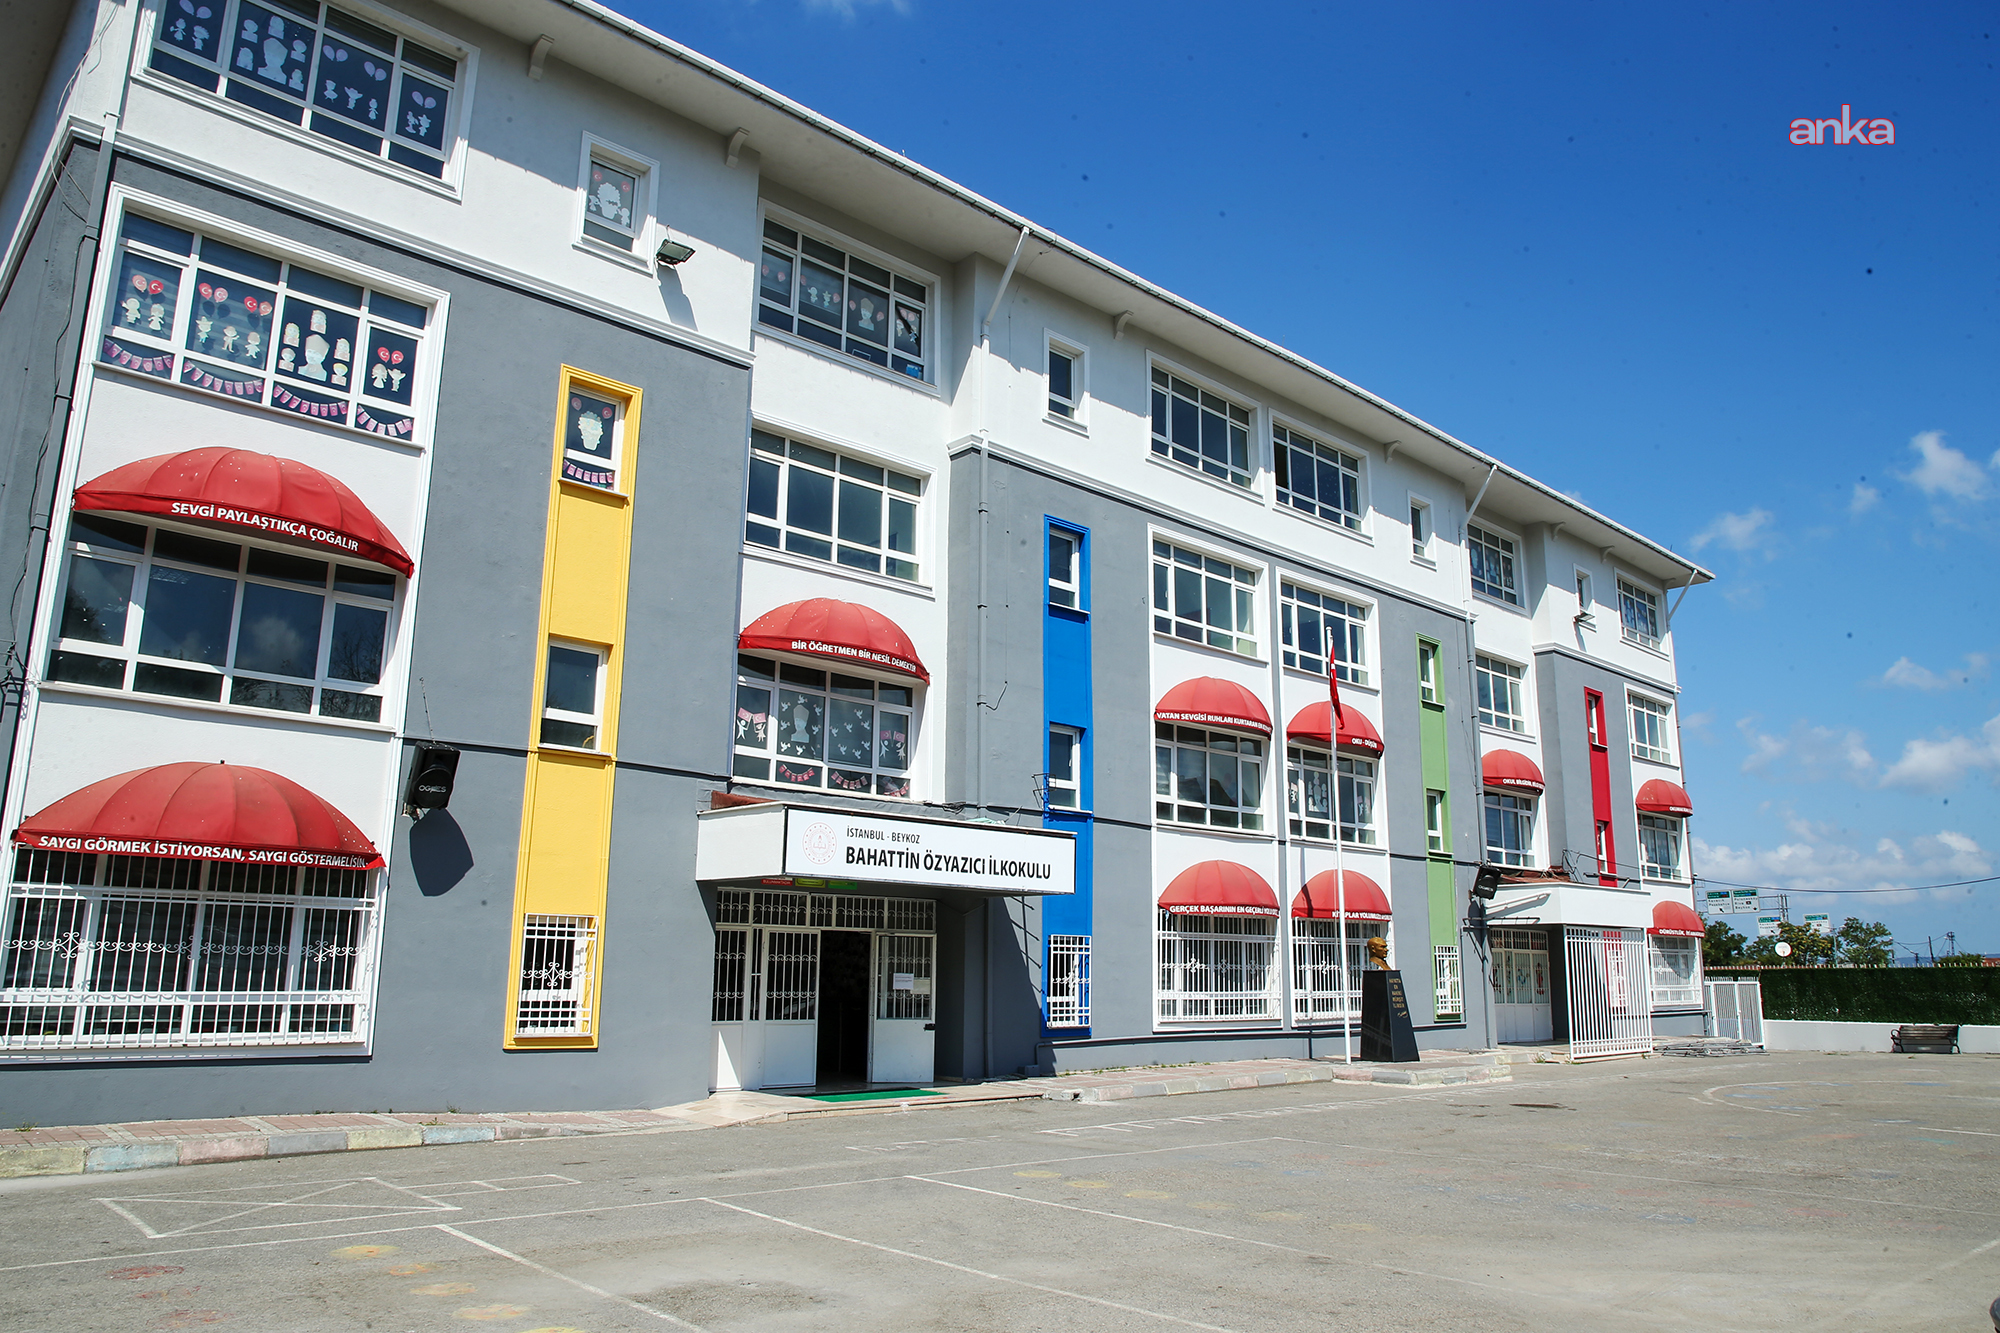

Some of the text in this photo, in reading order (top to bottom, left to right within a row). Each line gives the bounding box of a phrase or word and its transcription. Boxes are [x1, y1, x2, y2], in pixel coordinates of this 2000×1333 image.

[171, 502, 359, 551] SEVGİ PAYLAŞTIKÇA ÇOĞALIR
[791, 640, 917, 673] BİR ÖĞRETMEN BİR NESİL DEMEKTİR
[1156, 712, 1180, 720] VATAN
[1180, 713, 1207, 721] SEVGİSİ
[1207, 716, 1234, 724] RUHLARI
[846, 825, 885, 841] İSTANBUL
[891, 832, 920, 844] BEYKOZ
[38, 835, 83, 849] SAYGI
[84, 836, 151, 854] GÖRMEK
[154, 840, 246, 862] İSTİYORSAN,
[248, 850, 288, 863] SAYGI
[846, 846, 1051, 880] BAHATTİN ÖZYAZICI İLKOKULU
[1169, 905, 1199, 915] GERÇEK
[1200, 905, 1236, 914] BAŞARININ
[1332, 910, 1359, 918] KİTPLAR
